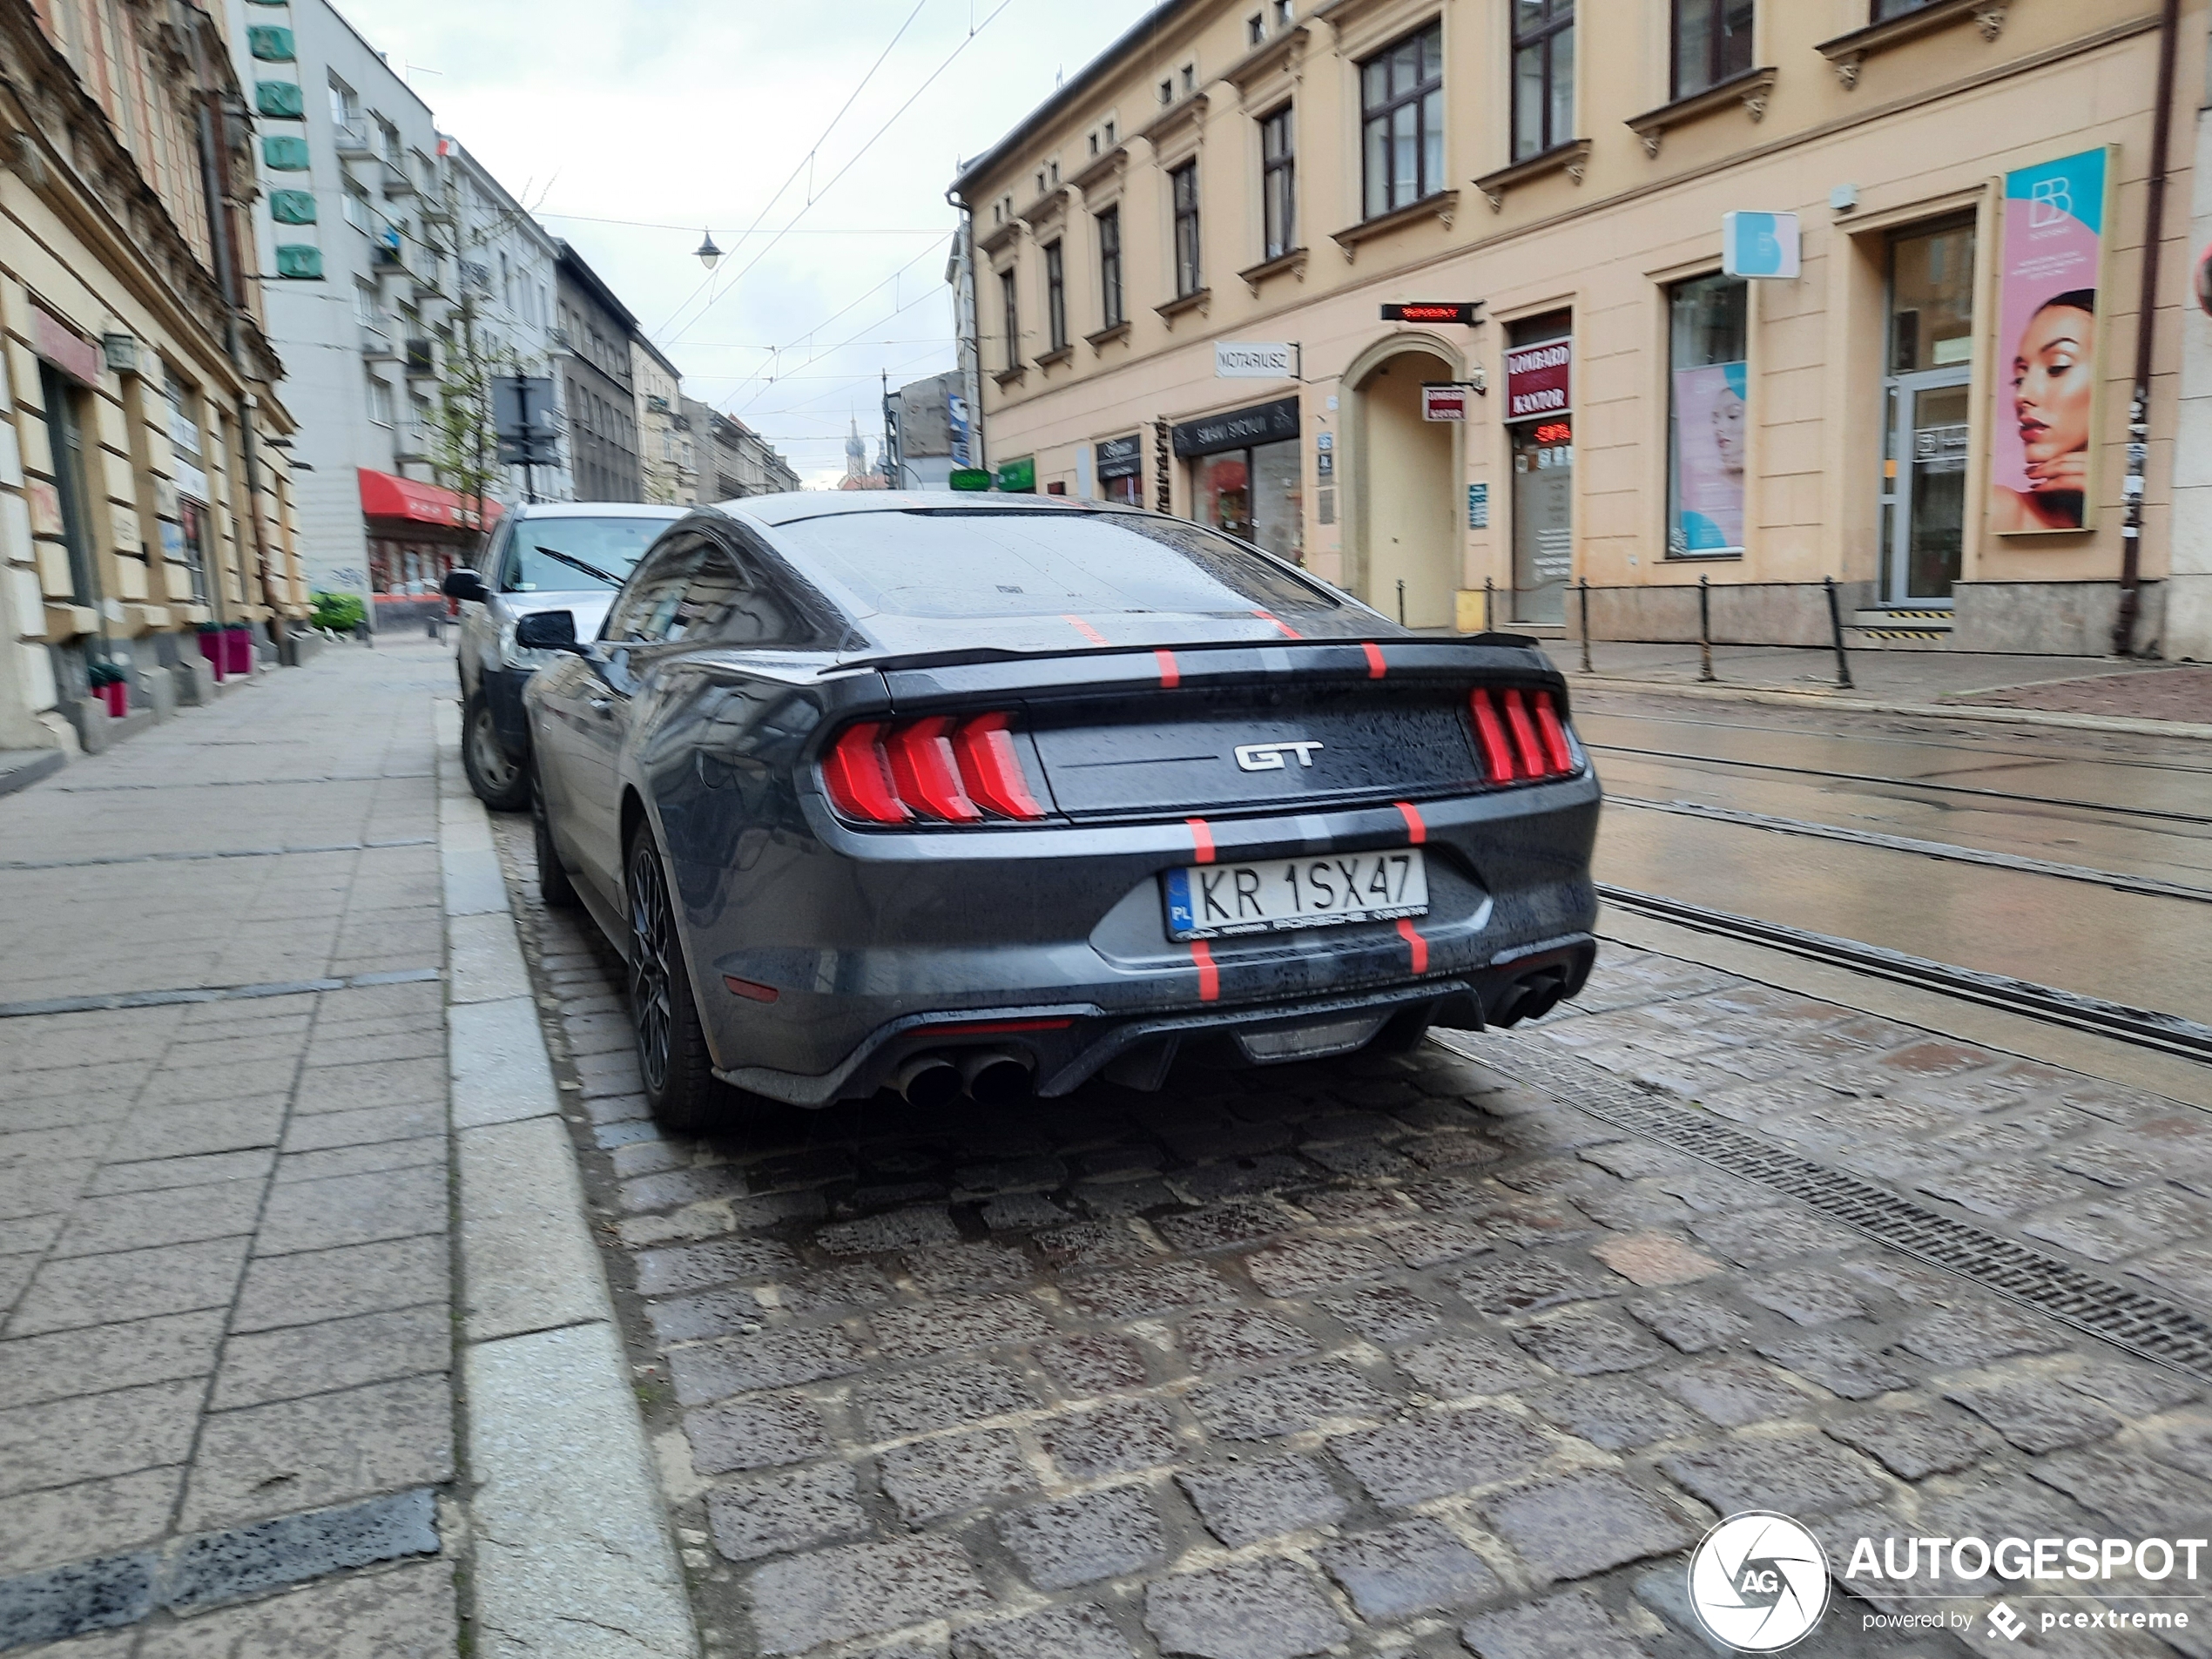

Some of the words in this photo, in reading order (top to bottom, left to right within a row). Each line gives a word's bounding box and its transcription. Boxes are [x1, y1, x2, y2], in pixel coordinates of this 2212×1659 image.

[1217, 351, 1287, 369] NOTARIUSZ
[1508, 346, 1569, 374] LOMBARD
[1513, 388, 1565, 414] KANTOR
[1234, 740, 1325, 772] GT
[1200, 867, 1264, 921] KR
[1285, 854, 1411, 913] 1SX47
[1170, 906, 1192, 922] PL
[1271, 911, 1368, 931] PORSCHE
